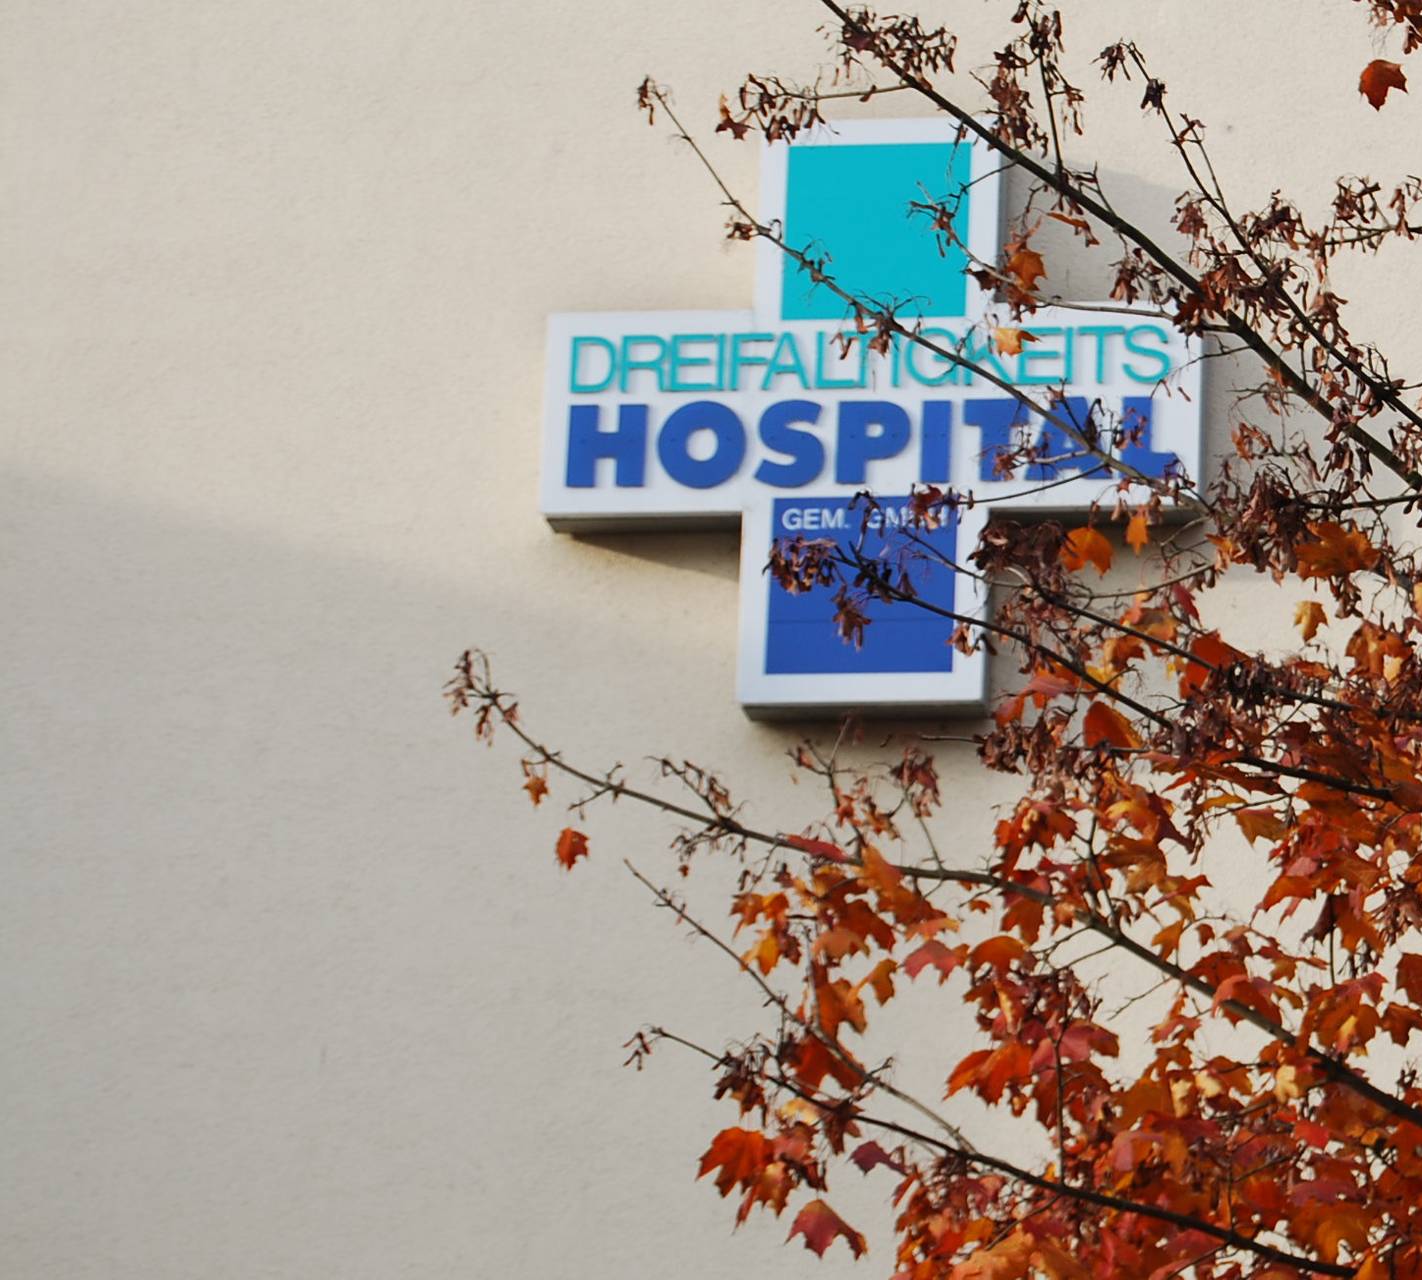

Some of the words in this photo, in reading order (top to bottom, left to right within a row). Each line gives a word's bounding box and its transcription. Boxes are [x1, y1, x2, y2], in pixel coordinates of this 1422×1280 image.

[570, 324, 1172, 393] DREIFALTIGKEITS
[565, 396, 1181, 490] HOSPITAL
[781, 507, 849, 531] GEM.
